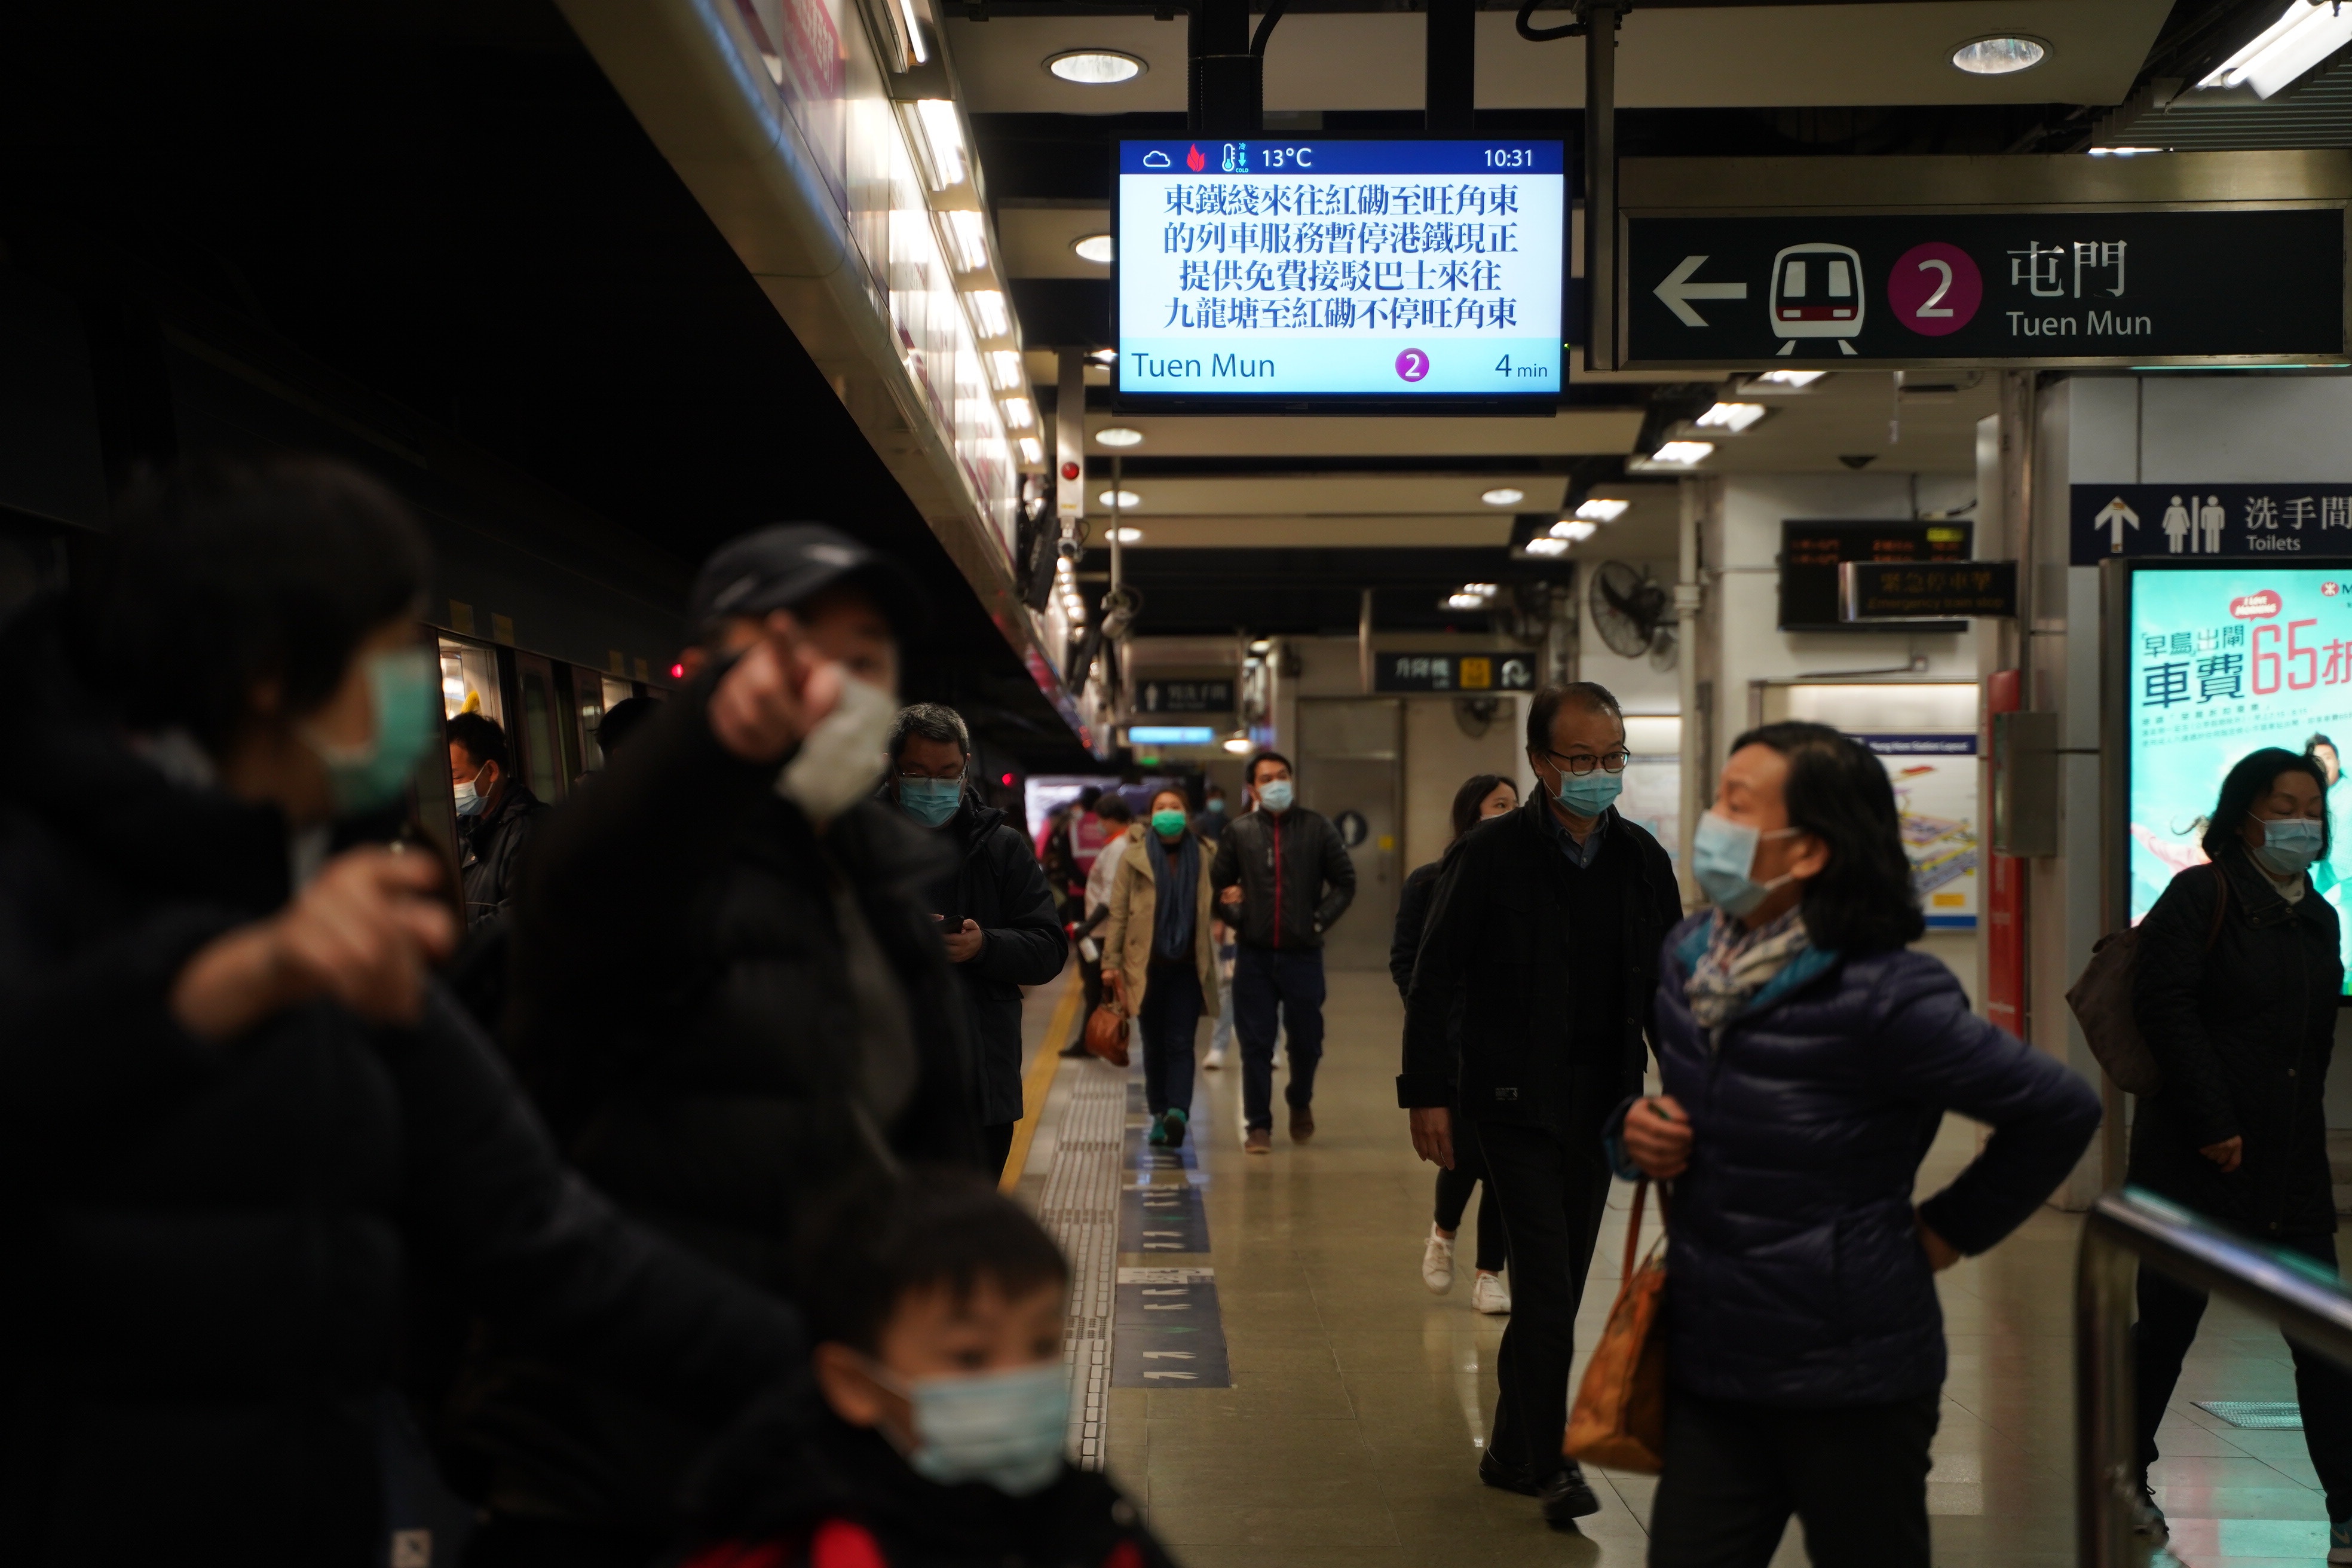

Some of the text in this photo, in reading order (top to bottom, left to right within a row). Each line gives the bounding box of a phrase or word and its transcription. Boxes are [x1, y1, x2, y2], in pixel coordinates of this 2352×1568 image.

[1262, 148, 1312, 167] 13°C
[1484, 149, 1532, 167] 10:31
[1165, 183, 1519, 216] 東鐵綫來往紅磡至旺角東
[1164, 221, 1518, 254] 的列車服務暫停港鐵現正
[1179, 259, 1502, 292] 提供免費接駁巴士來往
[2006, 240, 2127, 298] 屯門
[1915, 259, 1953, 317] 2
[1164, 296, 1517, 329] 九龍塘至紅磡不停旺角東
[2006, 310, 2151, 336] Tuen Mun
[1131, 353, 1275, 378] Tuen Mun
[1404, 353, 1420, 377] 2
[1494, 354, 1548, 378] 4 min
[2244, 495, 2352, 531] 洗手間
[2246, 535, 2301, 551] Toilets
[2142, 654, 2245, 709] 車費
